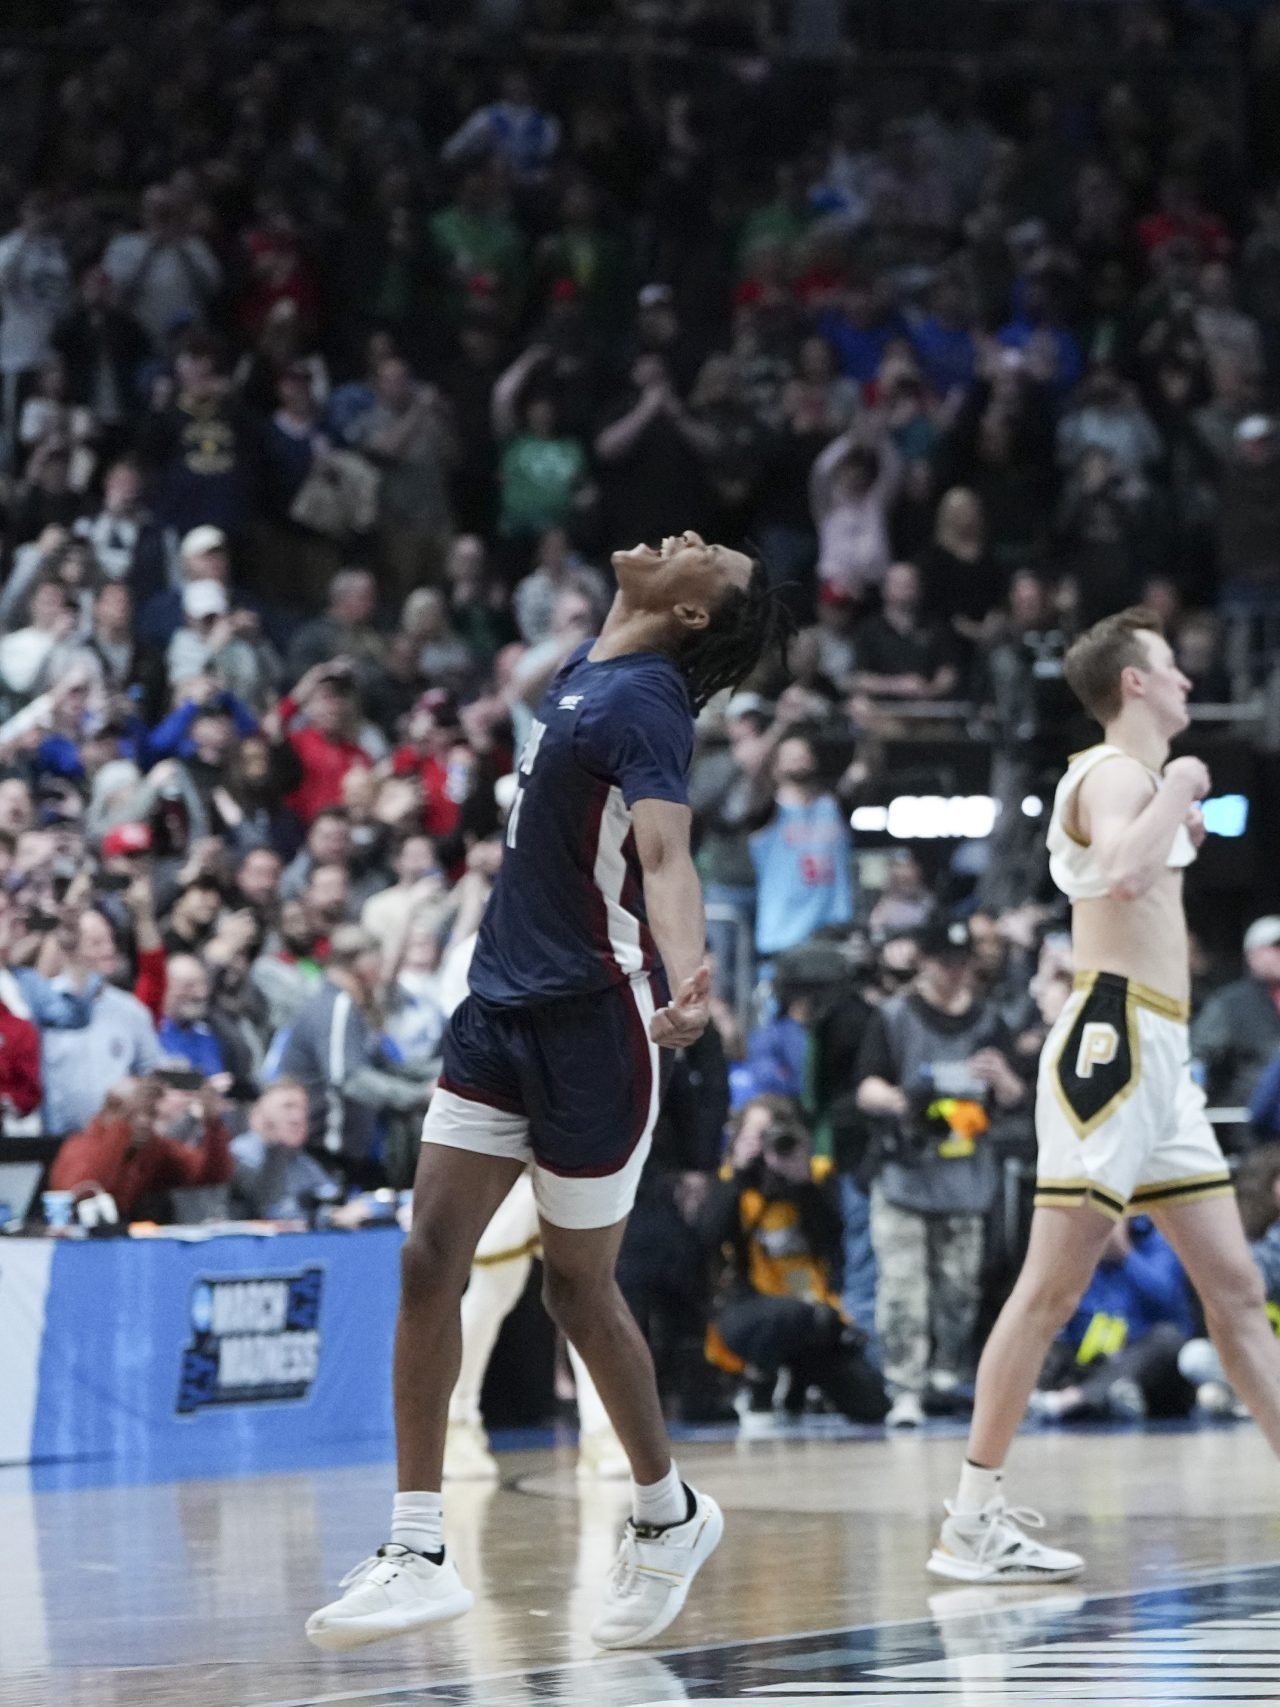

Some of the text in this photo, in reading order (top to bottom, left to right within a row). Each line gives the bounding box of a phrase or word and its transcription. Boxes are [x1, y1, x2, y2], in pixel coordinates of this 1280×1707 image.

[1075, 1022, 1120, 1079] P
[212, 1281, 289, 1335] MARCH
[217, 1330, 320, 1387] MADNESS
